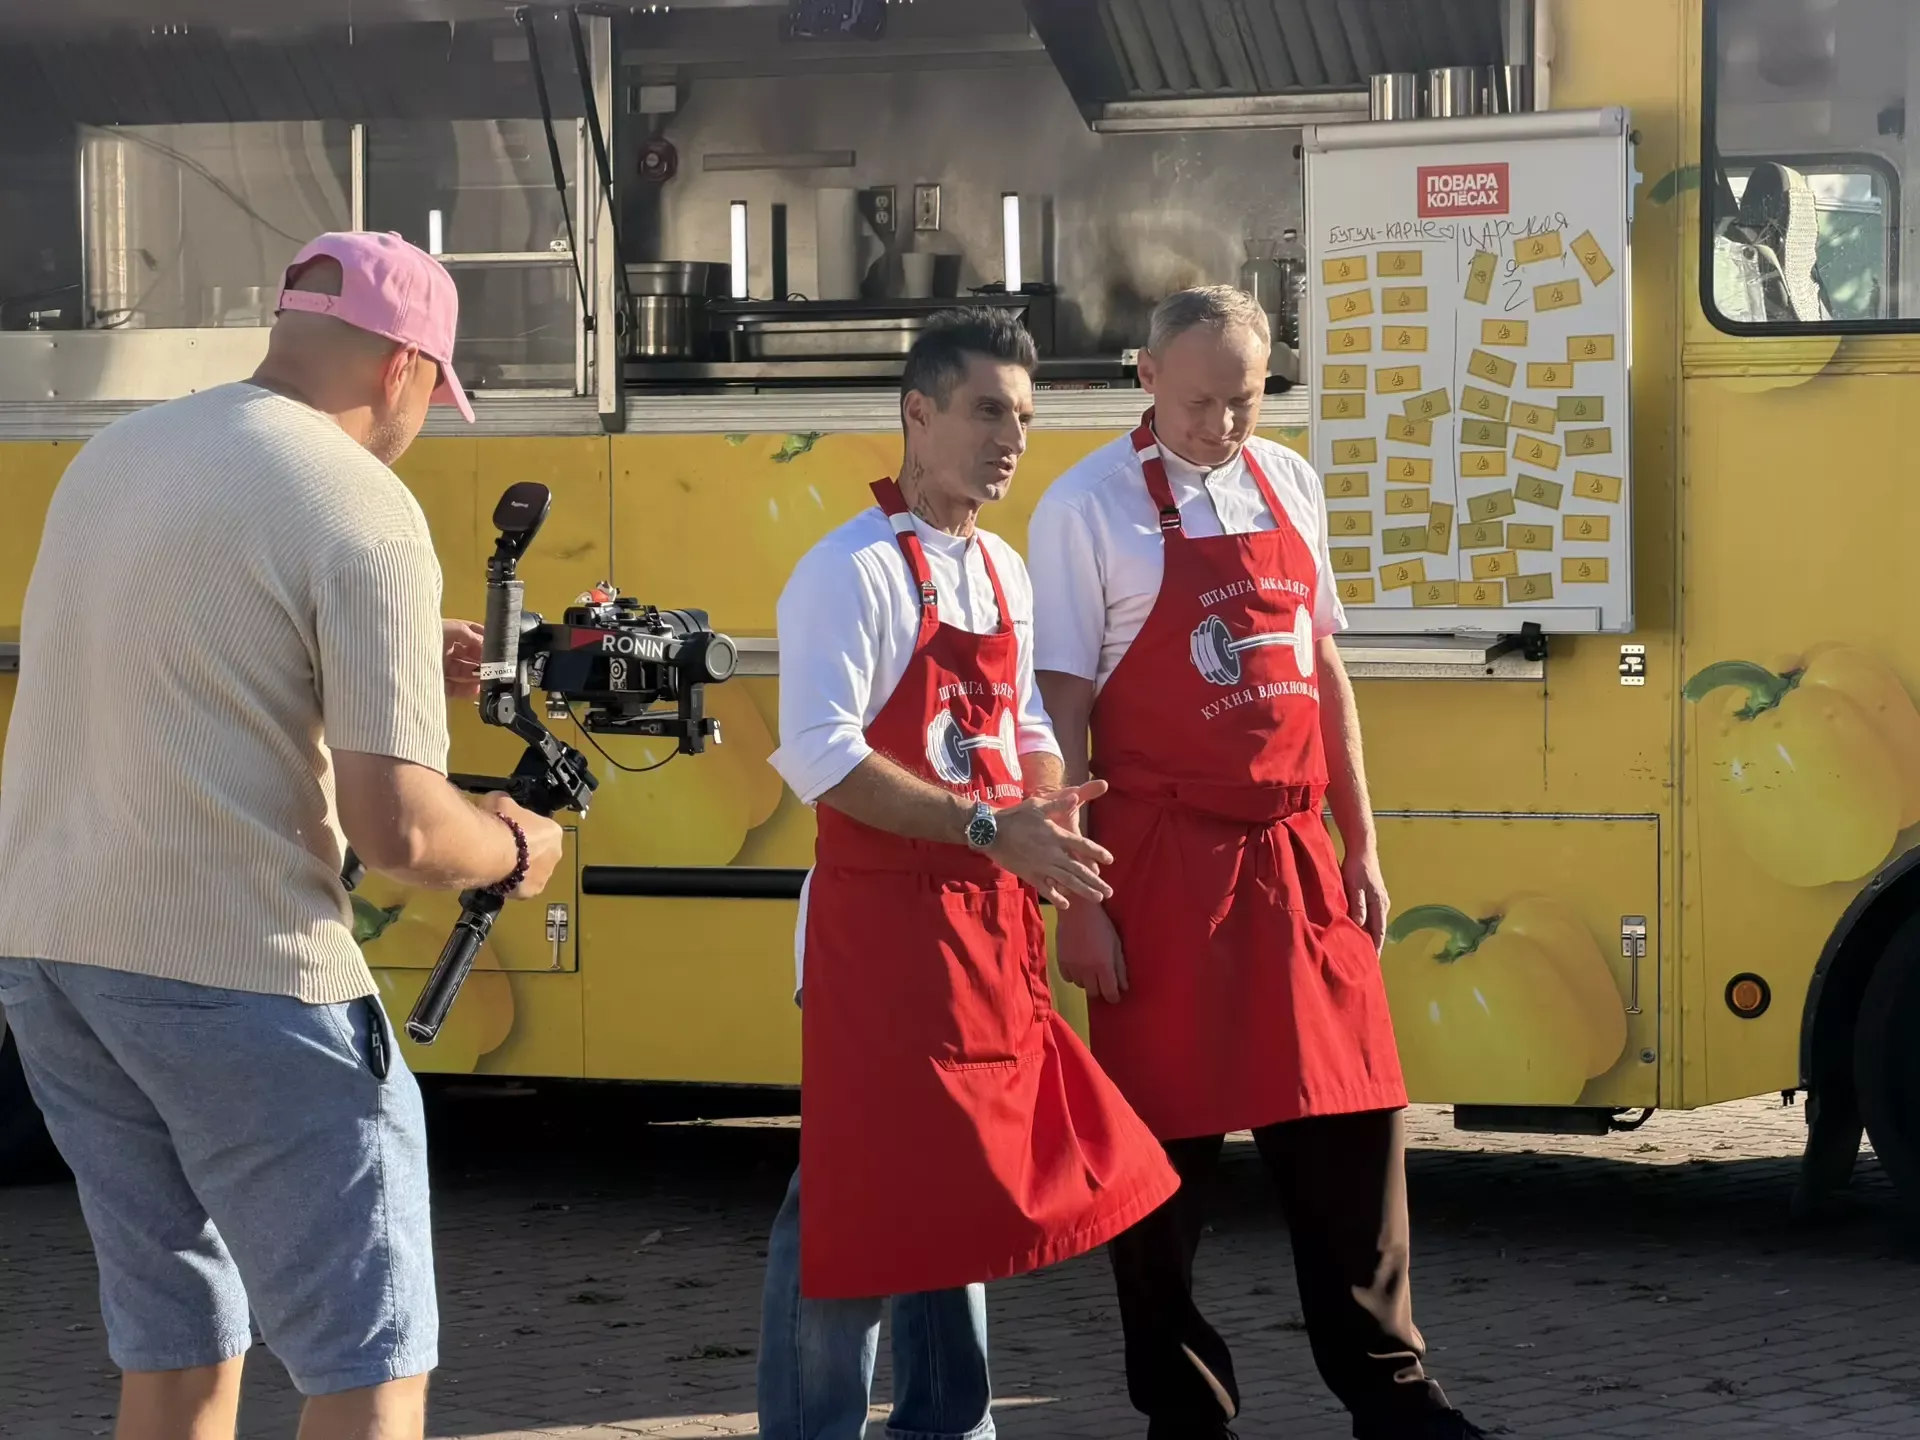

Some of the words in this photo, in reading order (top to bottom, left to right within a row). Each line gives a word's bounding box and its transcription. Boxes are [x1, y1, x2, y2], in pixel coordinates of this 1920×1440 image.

[1427, 173, 1499, 192] ПОВАРА
[1198, 579, 1257, 608] ШТАНГА
[1259, 577, 1310, 599] ЗАКАЛЯЕТ
[602, 634, 664, 659] RONIN
[938, 681, 985, 702] ШТАНГА
[1200, 688, 1254, 720] КУХНЯ
